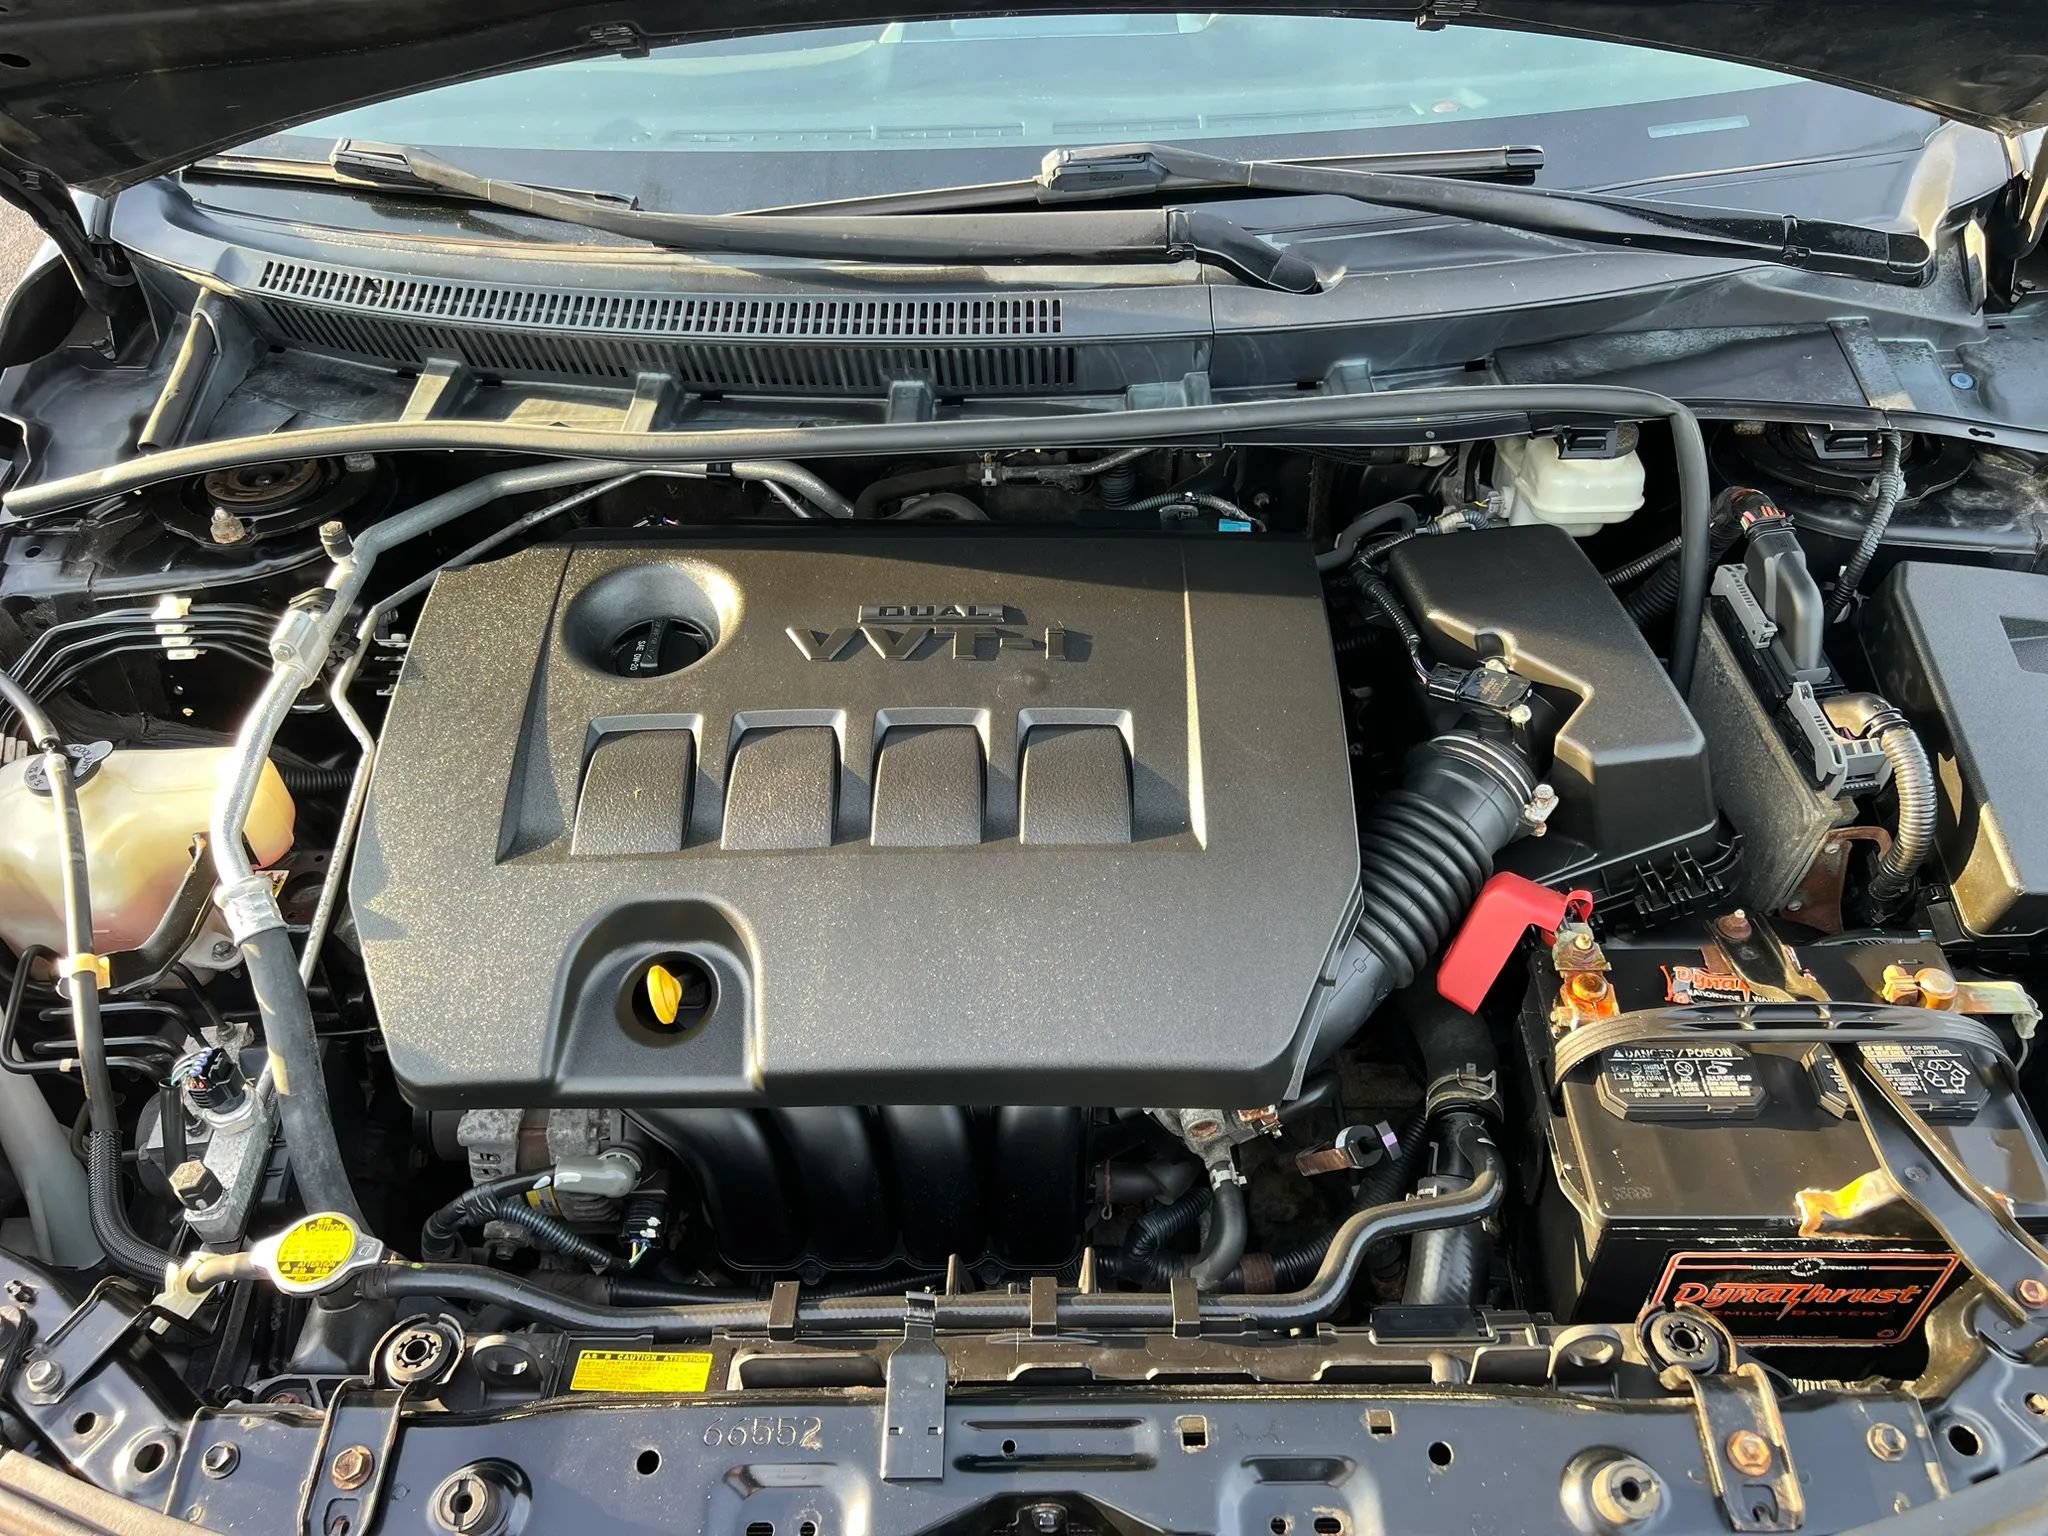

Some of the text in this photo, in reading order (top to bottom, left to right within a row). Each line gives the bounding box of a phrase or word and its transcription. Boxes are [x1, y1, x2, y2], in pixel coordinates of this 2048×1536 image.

[878, 604, 993, 617] DUAL
[635, 640, 647, 652] SAE
[1685, 1048, 1733, 1058] POISON
[1672, 1282, 1922, 1319] DynaThrust
[617, 1353, 658, 1361] CAUTION
[663, 1354, 706, 1363] ATTENTION
